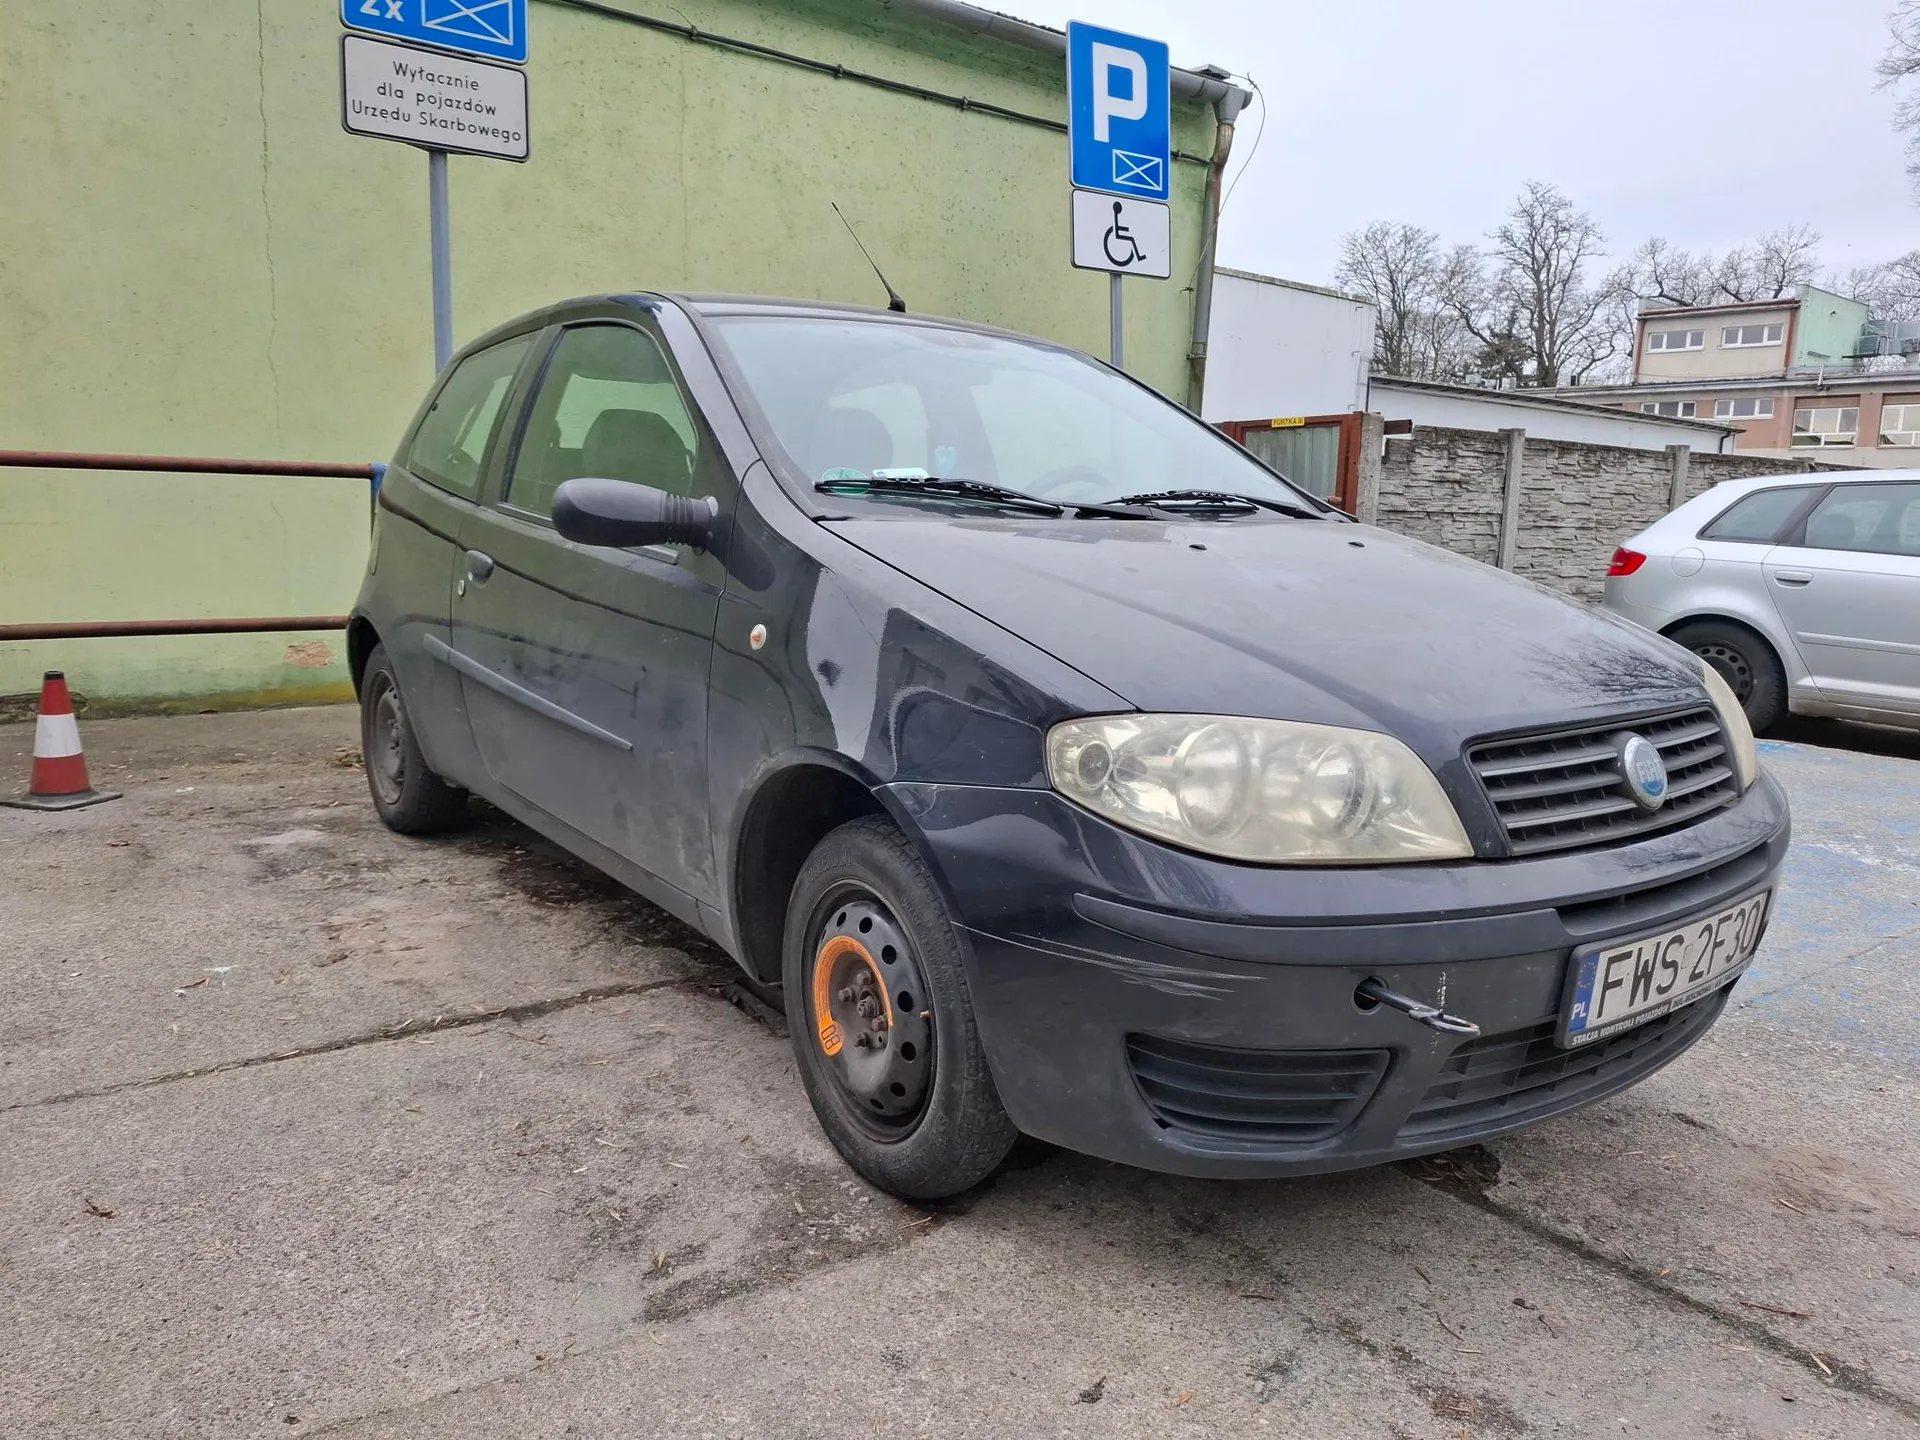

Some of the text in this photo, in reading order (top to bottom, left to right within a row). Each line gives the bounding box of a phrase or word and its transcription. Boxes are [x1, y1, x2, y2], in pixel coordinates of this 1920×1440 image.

[393, 60, 480, 91] Wyłącznie
[1092, 41, 1148, 143] P
[376, 82, 497, 116] dla pojazdów
[352, 99, 522, 143] Urzędu Skarbowego
[1596, 934, 1685, 1019] FWS
[1688, 900, 1761, 984] 2F30
[1571, 1001, 1587, 1020] PL
[1572, 1030, 1599, 1046] STACJA
[1600, 1017, 1635, 1037] KONTROLI
